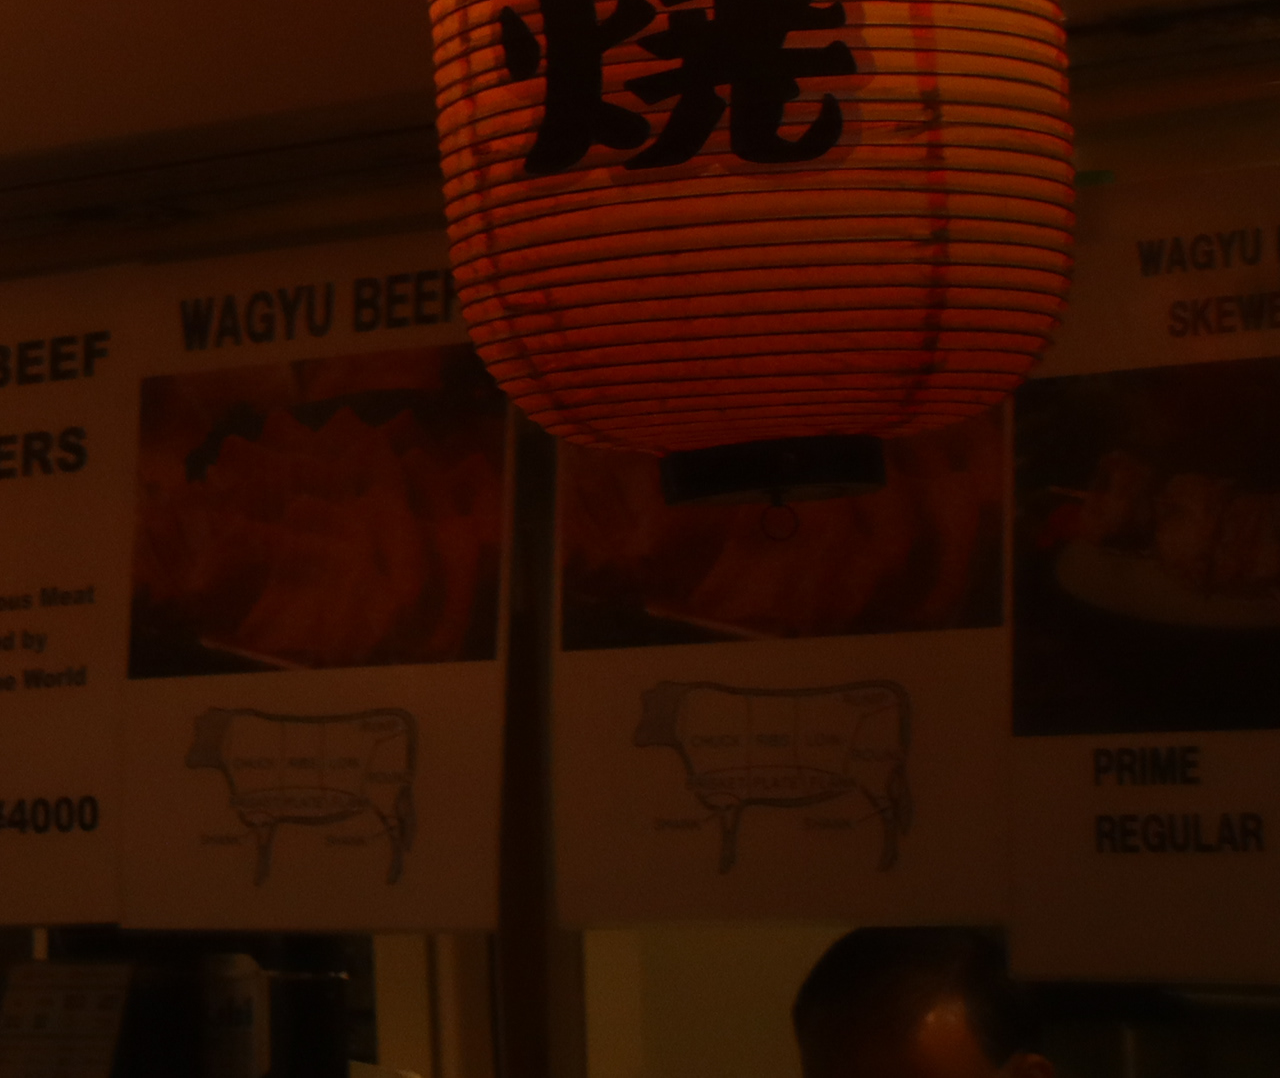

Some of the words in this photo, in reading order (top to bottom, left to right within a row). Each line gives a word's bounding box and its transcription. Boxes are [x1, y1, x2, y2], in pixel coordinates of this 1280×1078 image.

[1136, 226, 1264, 277] WAGYU
[181, 282, 335, 350] WAGYU
[40, 585, 96, 607] Meat
[21, 628, 49, 653] by
[23, 665, 87, 689] World
[1093, 745, 1201, 786] PRIME
[1095, 811, 1266, 853] REGULAR
